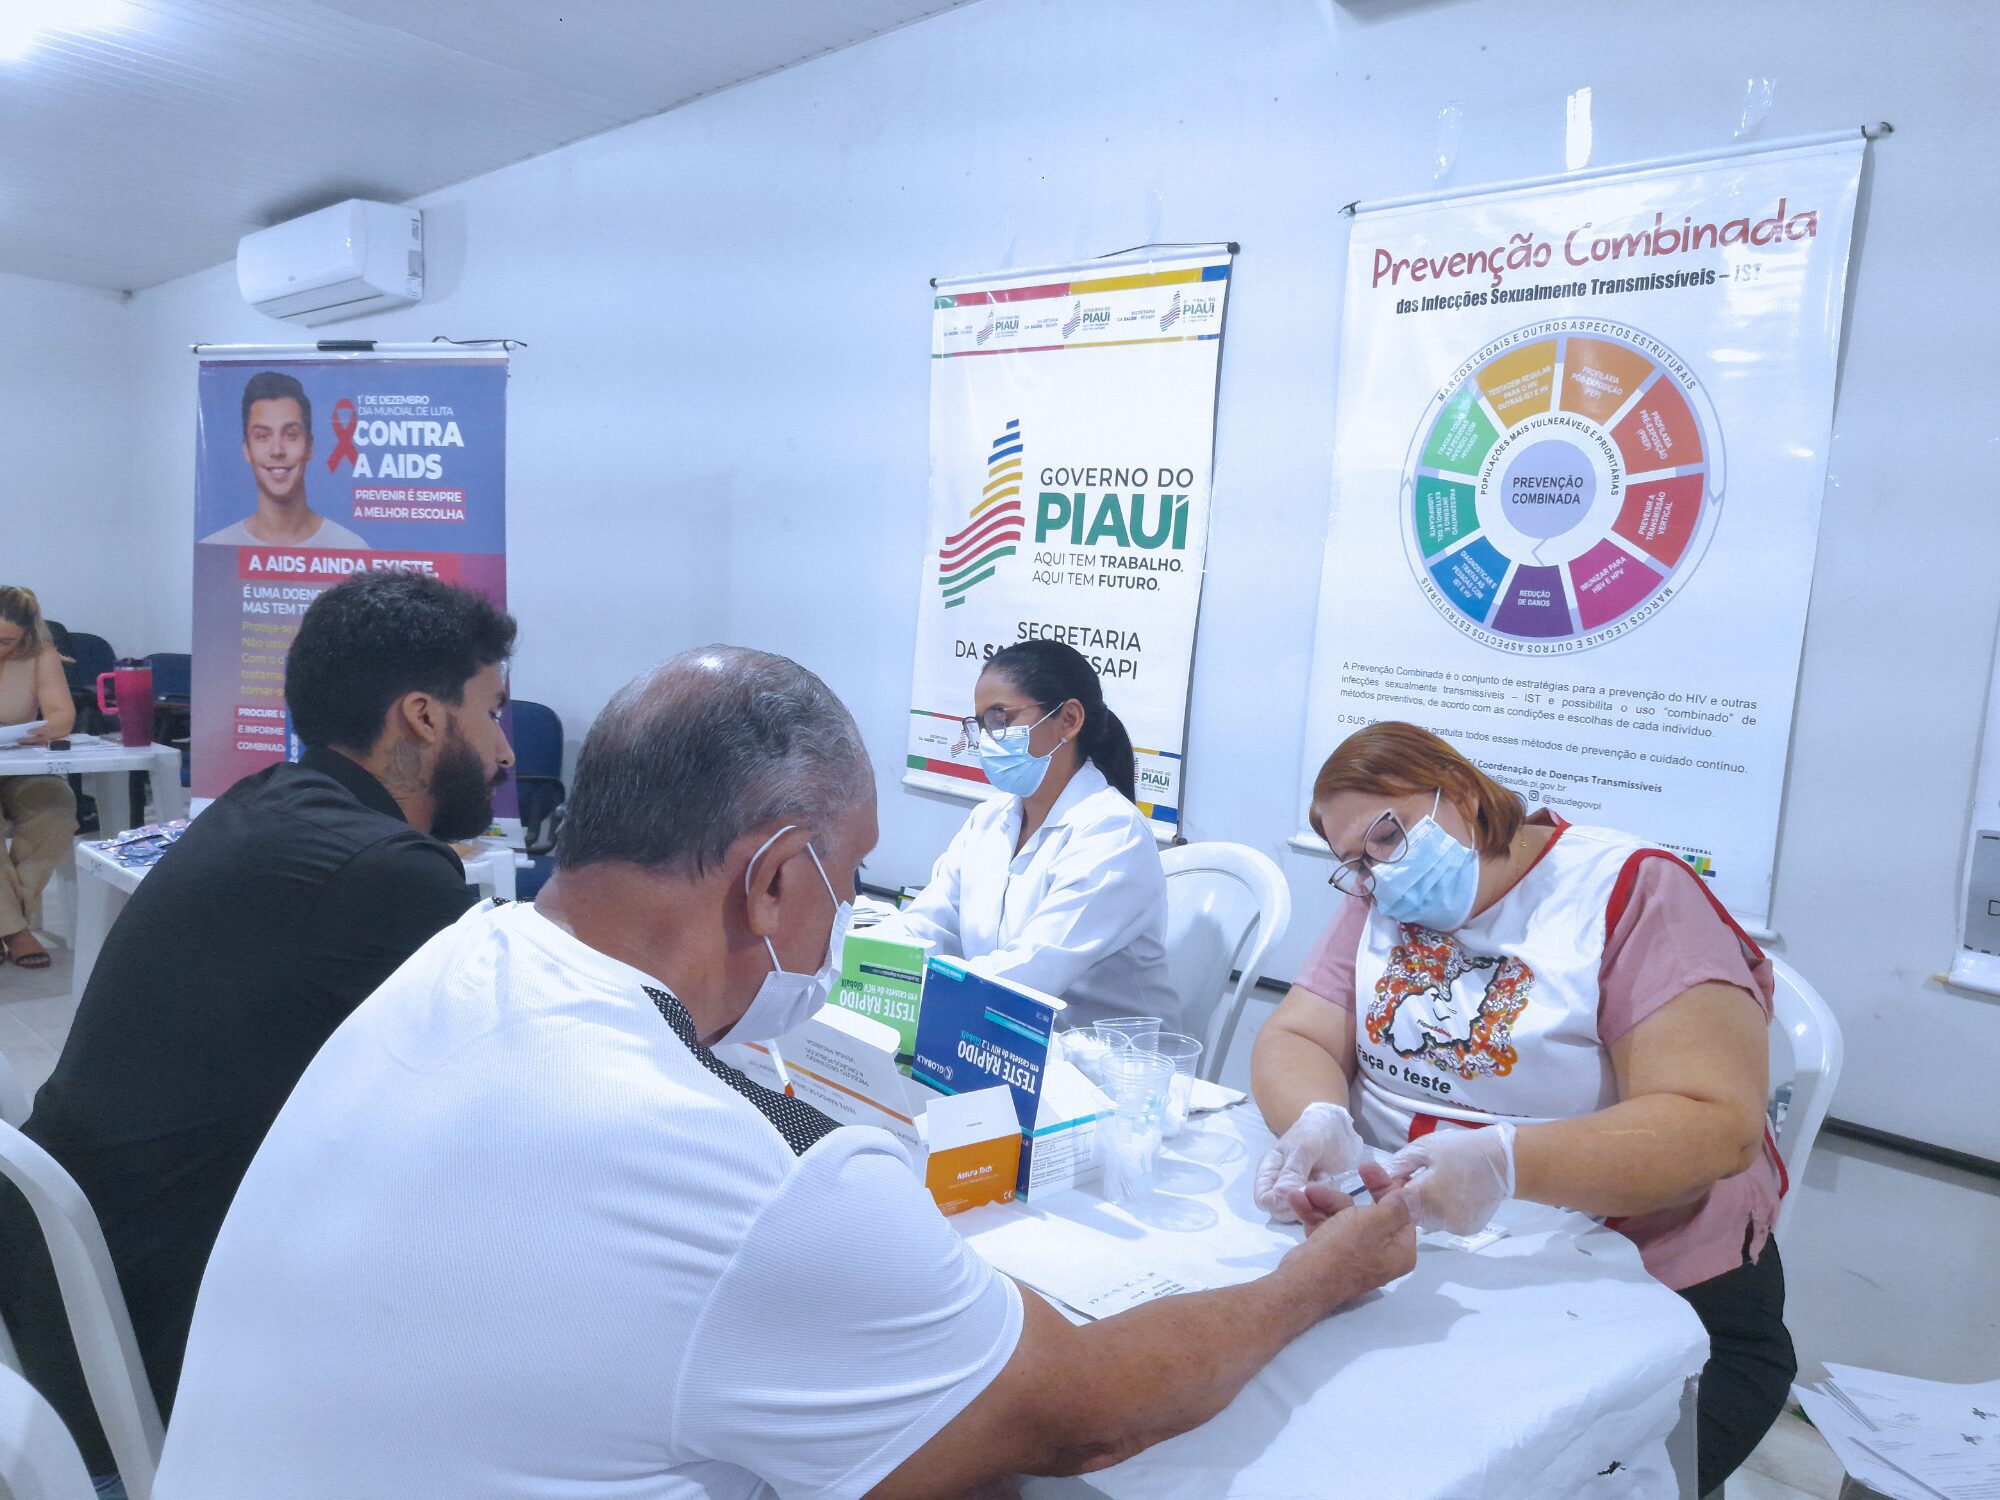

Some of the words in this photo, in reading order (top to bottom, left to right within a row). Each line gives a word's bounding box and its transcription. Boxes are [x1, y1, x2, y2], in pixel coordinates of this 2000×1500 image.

[1372, 232, 1552, 288] Prevenção
[1564, 197, 1818, 266] Combinada
[1396, 299, 1419, 314] das
[1421, 290, 1488, 311] Infecções
[1490, 281, 1587, 304] Sexualmente
[1591, 267, 1716, 296] Transmissíveis
[1437, 362, 1473, 402] MARCOS
[1473, 338, 1511, 366] LEGAIS
[1513, 333, 1520, 342] E
[1522, 321, 1567, 339] OUTROS
[1570, 321, 1631, 339] ASPECTOS
[1632, 333, 1697, 390] ESTRUTURAIS
[365, 395, 378, 405] DE
[379, 395, 430, 405] DEZEMBRO
[358, 406, 373, 415] DIA
[374, 406, 414, 416] MUNDIAL
[415, 406, 429, 416] DE
[430, 406, 454, 416] LUTA
[353, 420, 465, 447] CONTRA
[352, 453, 373, 478] A
[378, 453, 443, 480] AIDS
[1480, 439, 1510, 496] POPULAÇÕES
[1509, 424, 1530, 442] MAIS
[1531, 416, 1591, 434] VULNERÁVEIS
[1590, 430, 1598, 439] E
[1595, 434, 1620, 496] PRIORITÁRIAS
[1040, 467, 1149, 487] GOVERNO
[1157, 467, 1194, 488] DO
[1512, 474, 1585, 491] PREVENÇÃO
[355, 490, 406, 501] PREVENIR
[407, 488, 415, 501] É
[416, 490, 462, 502] SEMPRE
[1511, 493, 1581, 505] COMBINADA
[354, 506, 363, 517] A
[364, 507, 410, 518] MELHOR
[411, 508, 465, 520] ESCOLHA
[1034, 492, 1190, 550] PIAUÍ
[1638, 500, 1655, 535] PREVENIR
[1645, 491, 1666, 541] TRANSMISSÃO
[1657, 501, 1673, 535] VERTICAL
[248, 554, 262, 571] A
[266, 555, 306, 573] AIDS
[310, 556, 366, 575] AINDA
[1033, 551, 1065, 567] AQUI
[1069, 553, 1096, 567] TEM
[1100, 555, 1184, 573] TRABALHO.
[1032, 570, 1064, 586] AQUI
[1067, 572, 1094, 586] TEM
[1098, 573, 1160, 591] FUTURO.
[1580, 568, 1609, 592] IMUNIZAR
[1607, 555, 1627, 573] PARA
[1610, 568, 1625, 581] HPV
[243, 584, 251, 598] É
[253, 586, 280, 599] UMA
[1519, 588, 1551, 599] REDUÇÃO
[243, 602, 270, 614] MAS
[272, 603, 296, 615] TEM
[1421, 577, 1471, 632] ESTRUTURAIS
[1517, 598, 1527, 606] DE
[1527, 598, 1551, 607] DANOS
[1629, 587, 1674, 625] MARCOS
[1017, 621, 1142, 652] SECRETARIA
[1472, 628, 1525, 652] ASPECTOS
[1576, 639, 1584, 649] E
[1586, 622, 1629, 647] LEGAIS
[955, 640, 978, 660] DA
[1527, 642, 1573, 654] OUTROS
[1343, 661, 1349, 670] A
[1351, 662, 1394, 676] Prevenção
[1396, 666, 1443, 680] Combinada
[1445, 672, 1451, 680] é
[1454, 673, 1460, 681] o
[1461, 674, 1500, 686] conjunto
[1502, 677, 1513, 686] de
[1516, 679, 1569, 692] estratégias
[1572, 685, 1596, 694] para
[1599, 687, 1606, 695] a
[1608, 688, 1665, 701] prevenção
[1668, 692, 1682, 702] do
[1686, 693, 1707, 704] HIV
[1710, 697, 1718, 706] e
[1721, 698, 1757, 710] outras
[1340, 689, 1375, 700] métodos
[1377, 692, 1425, 706] preventivos,
[1427, 698, 1439, 707] de
[1441, 700, 1470, 711] acordo
[1472, 704, 1491, 713] com
[1494, 706, 1505, 715] as
[1507, 707, 1555, 720] condições
[1558, 713, 1564, 721] e
[1567, 714, 1613, 727] escolhas
[1616, 719, 1629, 728] de
[1633, 721, 1659, 731] cada
[1341, 675, 1379, 687] infecções
[1385, 679, 1437, 692] sexualmente
[1524, 693, 1542, 703] IST
[1548, 697, 1555, 705] e
[1562, 699, 1613, 711] possibilita
[1620, 705, 1628, 713] o
[1635, 706, 1655, 715] uso
[1742, 715, 1757, 725] de
[1337, 714, 1345, 723] O
[1347, 715, 1366, 725] SUS
[1431, 727, 1462, 738] gratuita
[1465, 730, 1489, 741] todos
[1492, 734, 1519, 745] esses
[1521, 737, 1563, 751] métodos
[1565, 743, 1578, 753] de
[1581, 746, 1637, 760] prevenção
[1640, 752, 1647, 760] e
[1649, 754, 1693, 767] cuidado
[1477, 760, 1533, 775] Coordenação
[1535, 767, 1547, 778] de
[1549, 770, 1589, 784] Doenças
[1591, 775, 1663, 793] Transmissíveis
[1542, 794, 1601, 811] @saudegovpi
[1682, 846, 1712, 856] FEDERAL
[840, 979, 863, 992] GlobalX
[863, 983, 875, 994] HCV
[874, 986, 884, 996] de
[884, 987, 905, 999] cassete
[905, 991, 918, 1001] em
[839, 989, 882, 1018] RÁPIDO
[883, 997, 917, 1023] TESTE
[957, 1040, 1002, 1076] RÁPIDO
[990, 1044, 1001, 1056] HIV
[1001, 1049, 1009, 1061] de
[916, 1053, 945, 1075] GLOBALX
[1009, 1053, 1030, 1069] cassete
[1027, 1063, 1040, 1073] em
[1357, 1044, 1384, 1071] Faça
[1389, 1065, 1398, 1076] o
[1403, 1067, 1452, 1095] teste
[1003, 1061, 1036, 1094] TESTE
[956, 1169, 978, 1181] Assura
